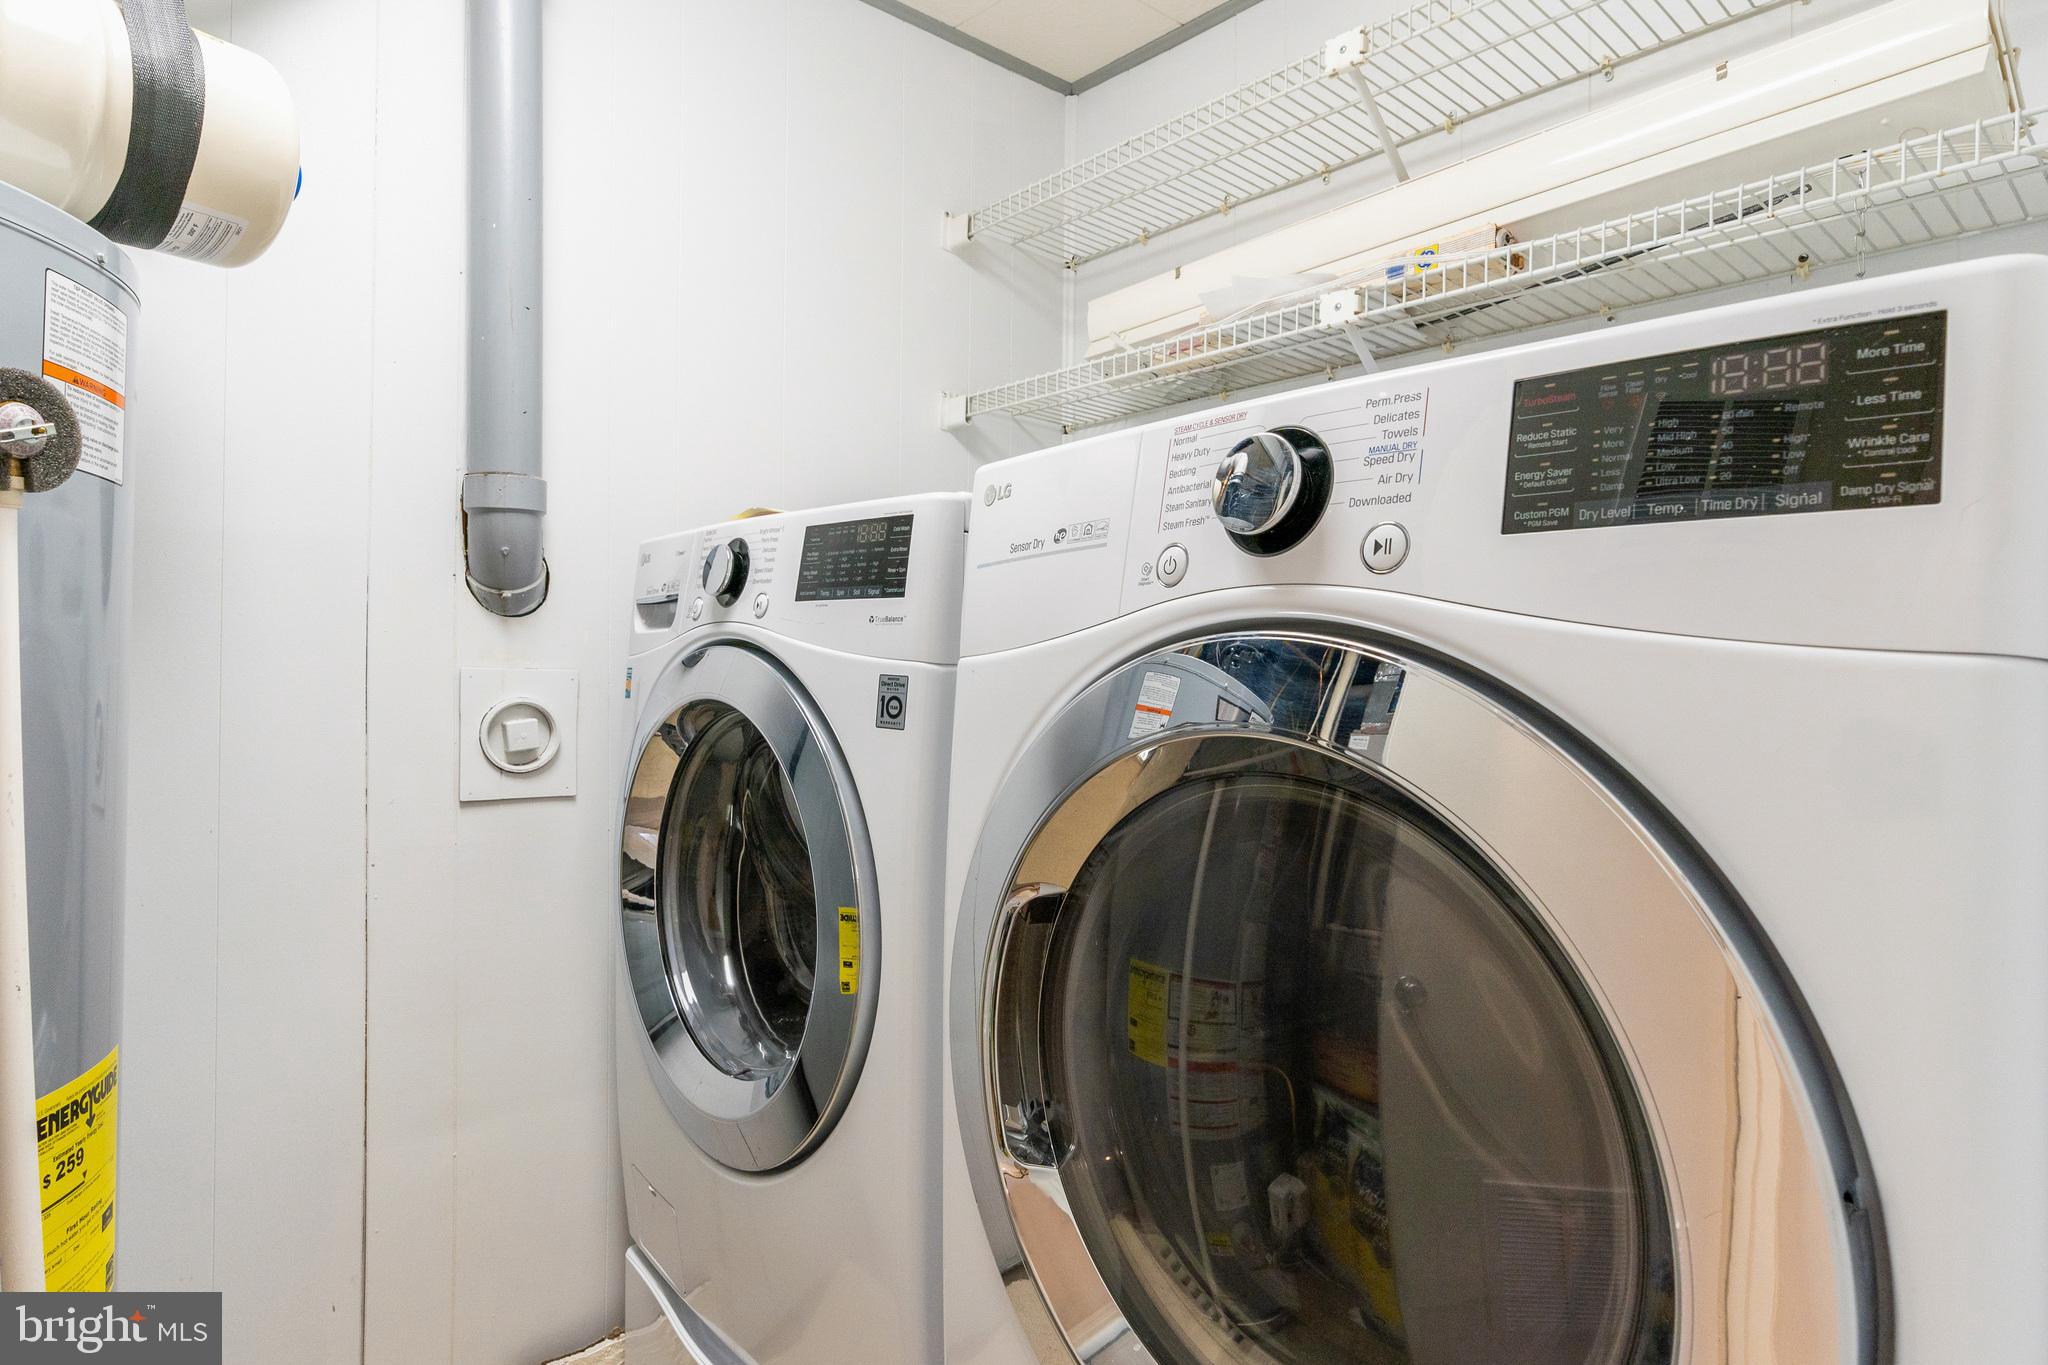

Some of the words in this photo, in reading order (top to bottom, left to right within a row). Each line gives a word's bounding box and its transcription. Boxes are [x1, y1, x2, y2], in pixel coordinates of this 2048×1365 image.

[1817, 315, 1838, 324] Extra
[1839, 311, 1872, 320] Function
[1857, 347, 1890, 360] More
[1892, 342, 1926, 354] Time
[79, 377, 106, 397] WARNING
[1366, 392, 1422, 408] Perm.Press
[1856, 395, 1887, 406] Less
[1889, 390, 1922, 402] Time
[1784, 401, 1825, 412] Remote
[1174, 425, 1192, 434] STEAM
[1192, 421, 1208, 430] CYCLE
[1214, 415, 1236, 424] SENSOR
[1236, 412, 1248, 420] DRY
[1374, 410, 1420, 424] Delicates
[1382, 426, 1418, 440] Towels
[1516, 431, 1549, 442] Reduce
[1550, 428, 1577, 438] Static
[1603, 426, 1624, 435] Very
[1173, 434, 1198, 446] Normal
[1528, 441, 1551, 449] Remote
[1603, 440, 1624, 449] More
[1847, 435, 1897, 448] Wrinkle
[1900, 433, 1930, 444] Care
[1368, 443, 1401, 454] MANUAL
[1402, 441, 1418, 450] DRY
[1657, 447, 1693, 457] Medium
[1171, 451, 1192, 462] Heavy
[1194, 448, 1211, 457] Duty
[1363, 453, 1395, 468] Speed
[1397, 451, 1416, 463] Dry
[1602, 453, 1633, 463] Normal
[1169, 466, 1197, 479] Bedding
[1514, 471, 1546, 481] Energy
[1547, 468, 1574, 478] Saver
[1600, 469, 1621, 477] Less
[1656, 463, 1676, 472] Low
[1783, 465, 1799, 475] Off
[1377, 474, 1393, 485] Air
[1395, 472, 1414, 484] Dry
[1523, 480, 1545, 488] Default
[1546, 478, 1568, 486] On/Off
[1167, 479, 1212, 496] Antibacterial
[1600, 483, 1625, 492] Damp
[1840, 485, 1873, 496] Damp
[1874, 483, 1896, 495] Dry
[1897, 481, 1935, 494] Signal
[1165, 502, 1184, 513] Steam
[1185, 499, 1212, 510] Sanitary
[1349, 492, 1412, 508] Downloaded
[1701, 499, 1732, 512] Time
[1735, 497, 1759, 510] Dry
[1775, 491, 1822, 508] Signal
[1514, 511, 1548, 520] Custom
[1548, 507, 1569, 517] PGM
[1579, 509, 1599, 522] Dry
[1600, 506, 1631, 519] Level
[1162, 520, 1184, 531] Steam
[1010, 540, 1032, 554] Sensor
[1033, 538, 1046, 551] Dry
[880, 695, 903, 720] 10
[37, 1064, 118, 1142] ENERGYGUIDE
[55, 1147, 85, 1182] 259
